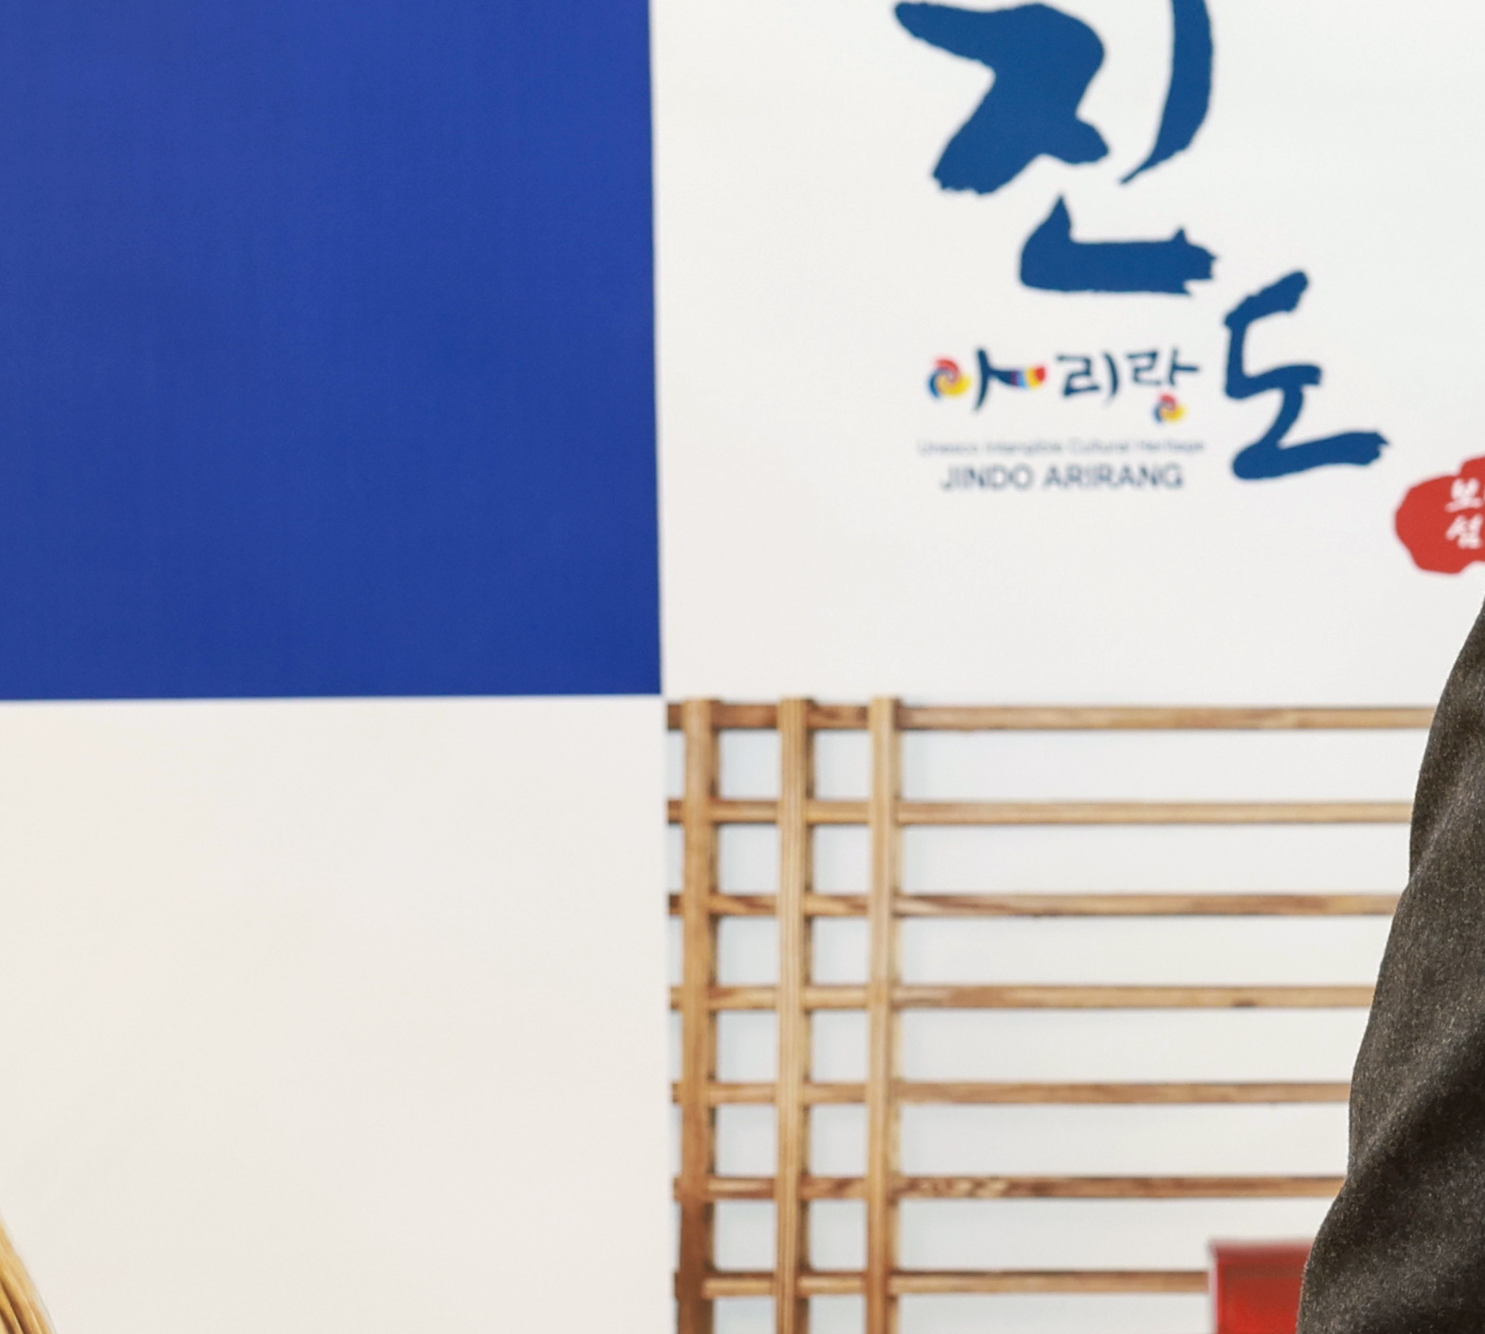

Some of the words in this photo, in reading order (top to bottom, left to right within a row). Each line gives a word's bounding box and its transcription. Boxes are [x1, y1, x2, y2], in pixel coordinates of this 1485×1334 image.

[927, 345, 1201, 425] 아리랑
[940, 465, 1035, 490] JINDO
[1042, 463, 1184, 490] ARIRANG
